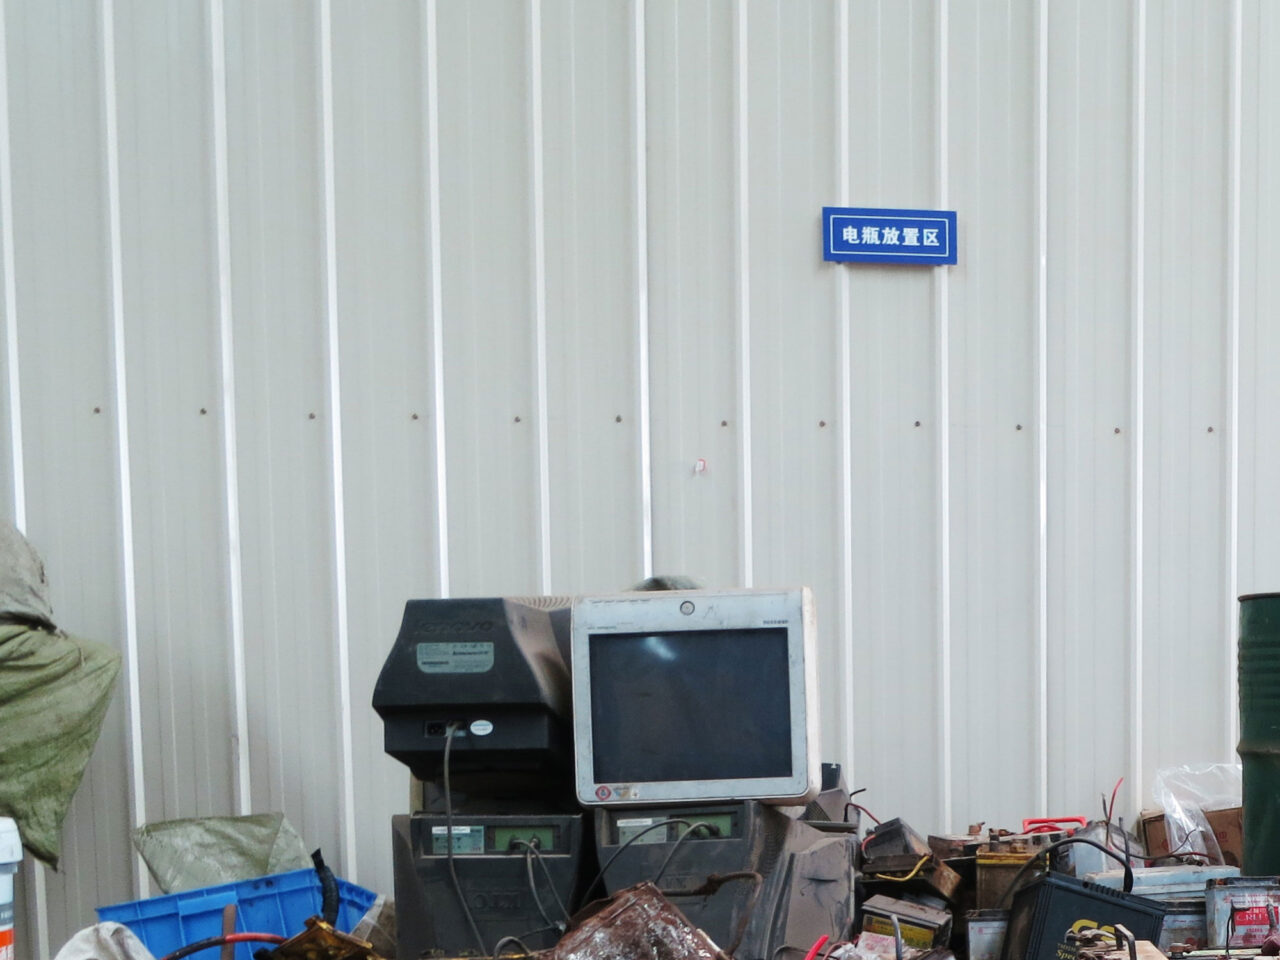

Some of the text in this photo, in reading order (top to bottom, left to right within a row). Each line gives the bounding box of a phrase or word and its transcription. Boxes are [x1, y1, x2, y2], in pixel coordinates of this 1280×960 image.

[843, 225, 940, 246] 电瓶放置区
